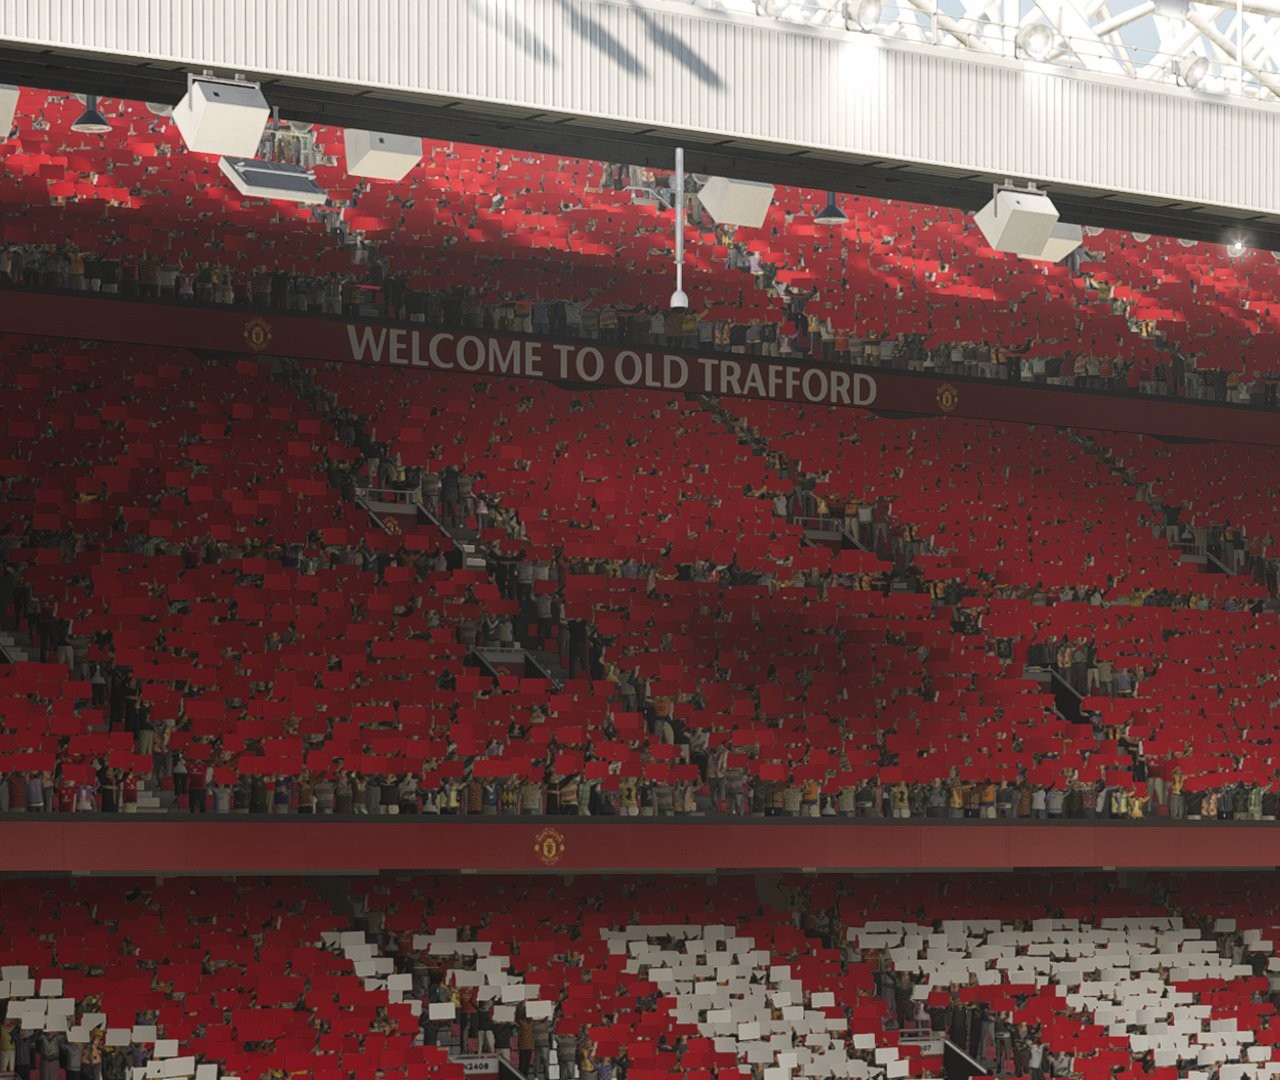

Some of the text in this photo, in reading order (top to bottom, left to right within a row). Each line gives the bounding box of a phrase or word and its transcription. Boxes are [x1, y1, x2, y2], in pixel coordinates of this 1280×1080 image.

[346, 324, 878, 407] WELCOME TO OLD TRAFFORD
